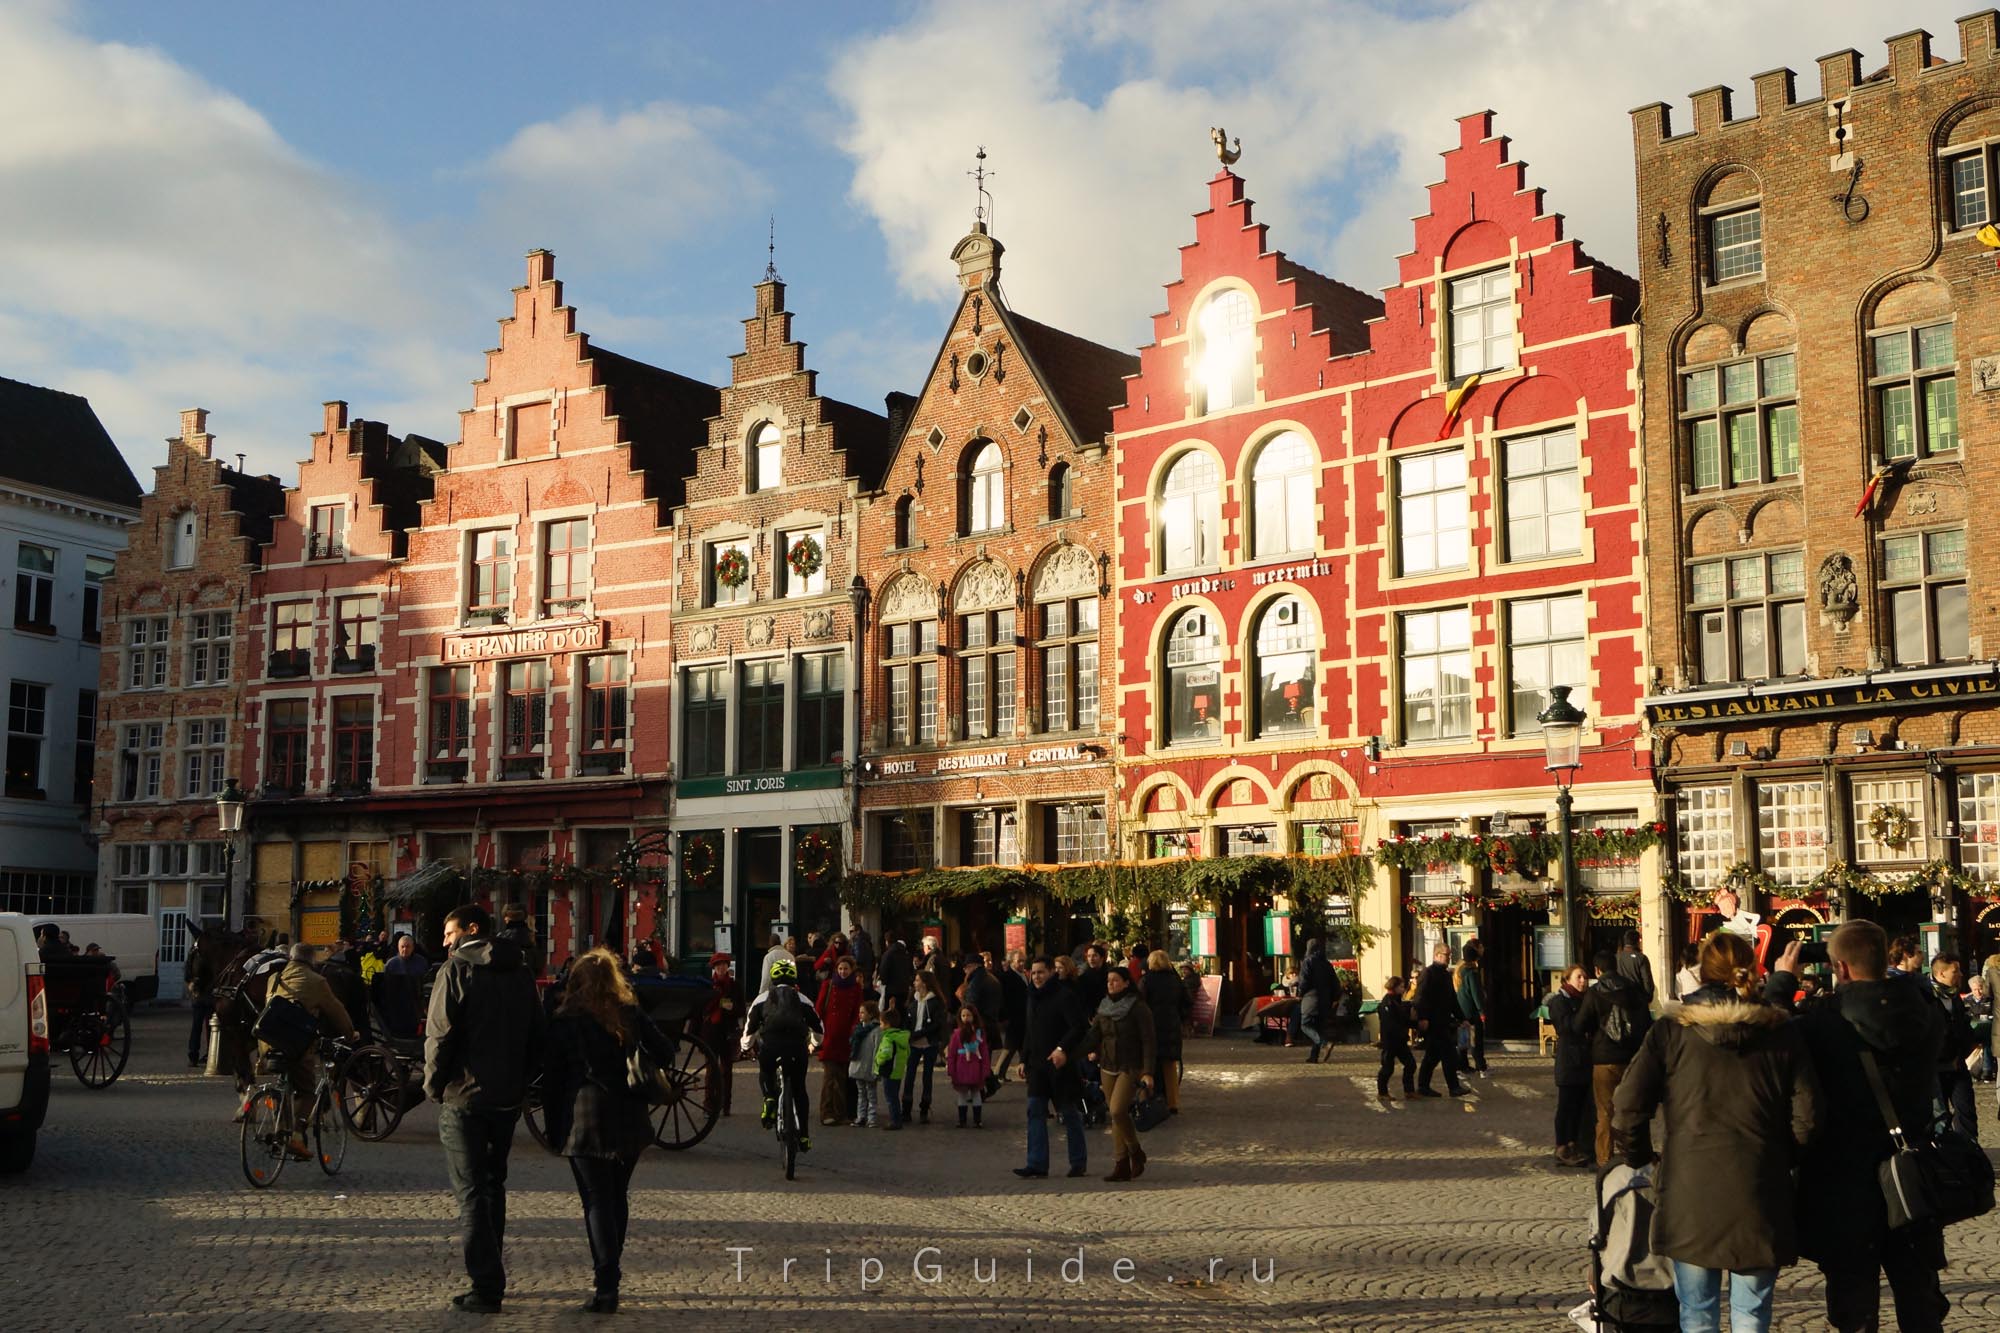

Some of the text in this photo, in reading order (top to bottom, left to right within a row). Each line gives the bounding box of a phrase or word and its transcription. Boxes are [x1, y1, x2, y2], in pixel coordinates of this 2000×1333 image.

[1253, 558, 1331, 585] meermin
[448, 625, 601, 659] LE PANIER D'OR
[1857, 685, 1896, 704] LA
[882, 746, 1081, 775] HOTEL RESTAURANT CENTRAL
[726, 776, 786, 793] SINT JORIS
